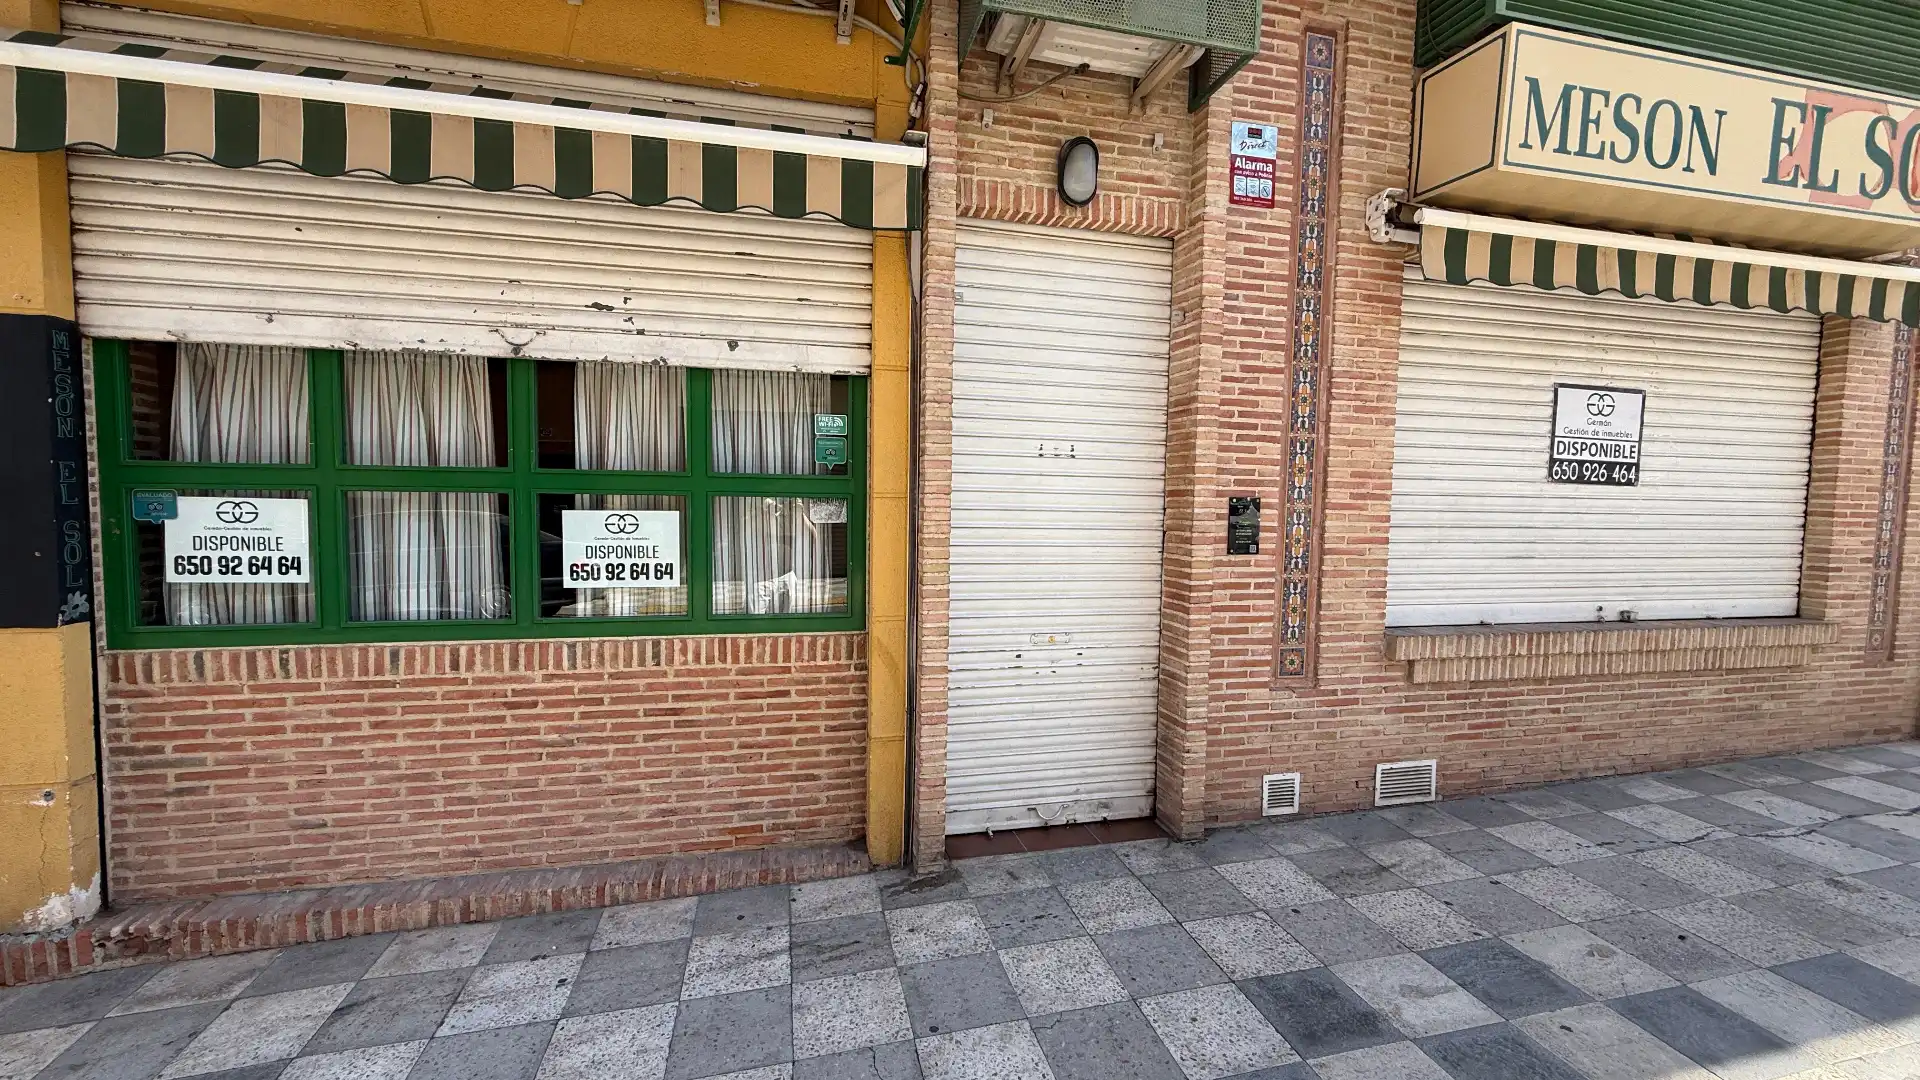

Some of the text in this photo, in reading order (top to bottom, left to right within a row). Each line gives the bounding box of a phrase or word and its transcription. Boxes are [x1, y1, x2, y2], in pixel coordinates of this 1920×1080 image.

[1518, 76, 1727, 176] MESON
[1762, 97, 1839, 194] EL
[1235, 157, 1272, 172] Alarma
[1587, 418, 1611, 427] Germán
[1563, 427, 1589, 436] Gestión
[1602, 430, 1633, 438] inmuebles
[1556, 440, 1636, 460] DISPONIBLE
[1553, 462, 1635, 483] 650 926 464
[58, 461, 79, 504] EL
[192, 535, 284, 551] DISPONIBLE
[585, 545, 660, 559] DISPONIBLE
[63, 520, 83, 587] SOL
[174, 555, 302, 576] 650 92 64 64
[569, 563, 674, 581] 650 92 64 64
